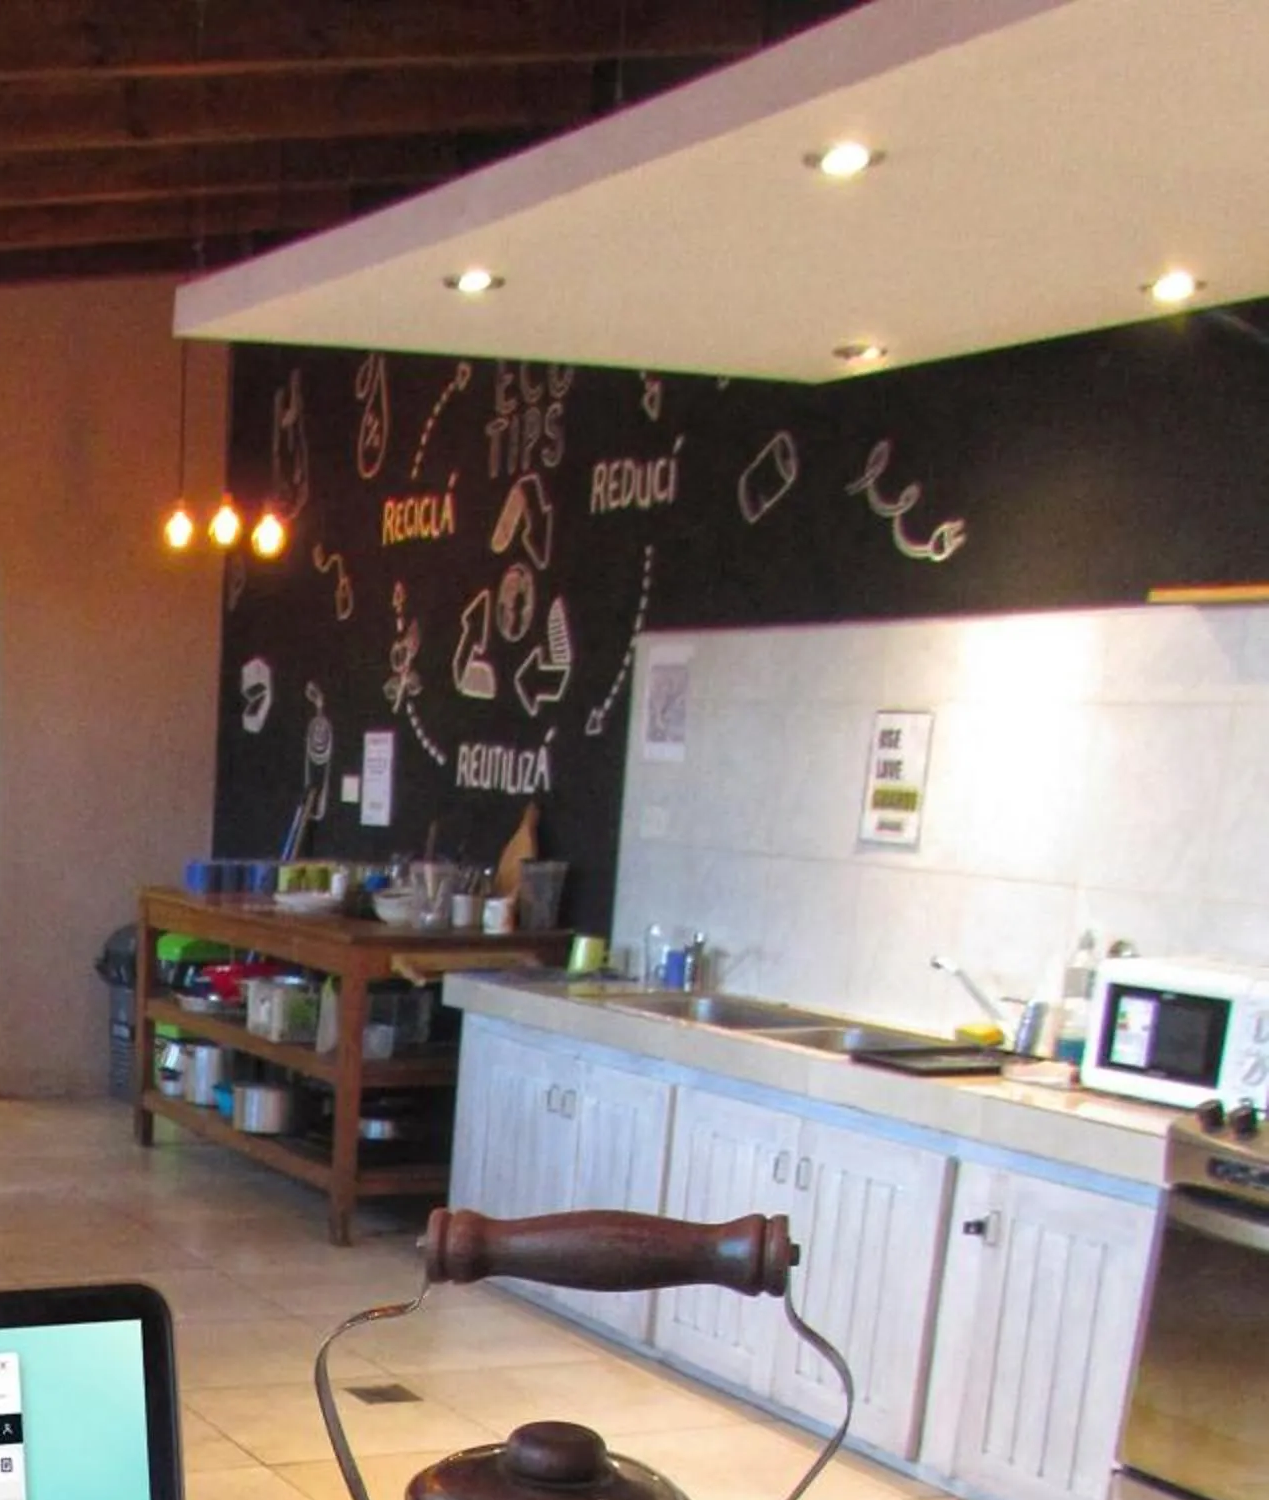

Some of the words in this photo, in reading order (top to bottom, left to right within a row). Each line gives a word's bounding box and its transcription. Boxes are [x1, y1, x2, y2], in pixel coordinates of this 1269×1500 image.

[484, 401, 566, 479] TIPS
[590, 434, 685, 514] REDUCÍ
[382, 472, 459, 546] RECICLÁ
[455, 726, 557, 795] REUTILIZÁ
